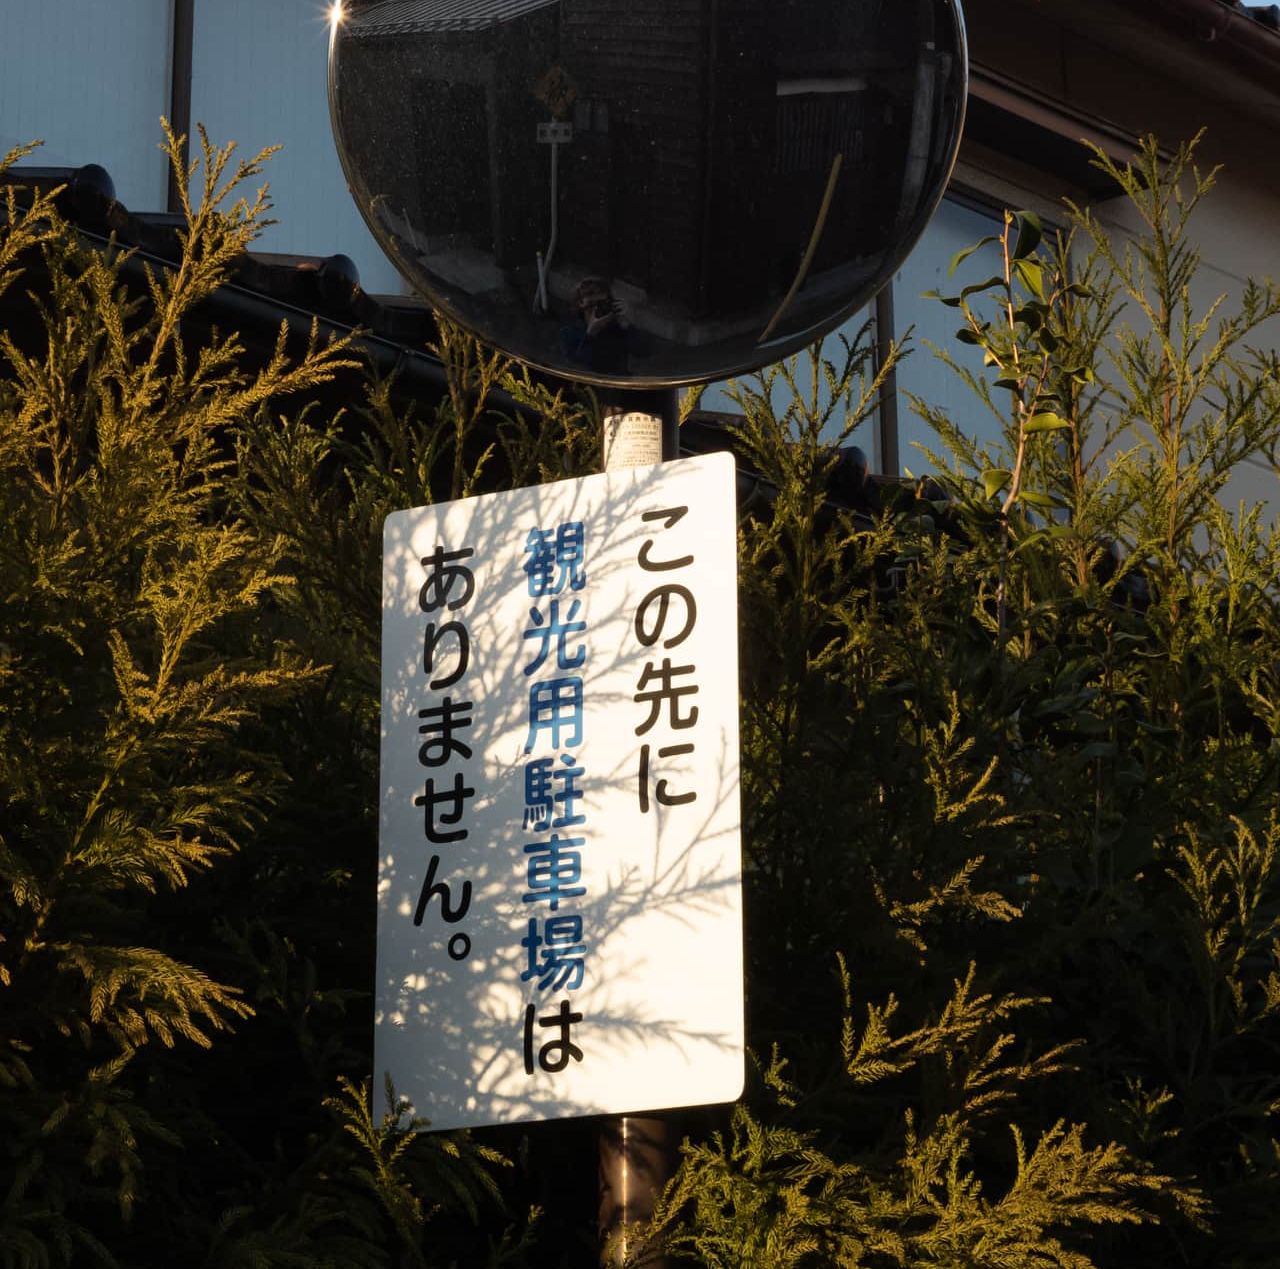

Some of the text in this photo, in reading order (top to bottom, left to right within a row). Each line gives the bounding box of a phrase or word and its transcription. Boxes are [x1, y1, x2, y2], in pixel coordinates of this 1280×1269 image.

[414, 546, 475, 961] ありません。
[521, 521, 587, 1075] 観光用駐車場は
[634, 506, 698, 813] この先に
